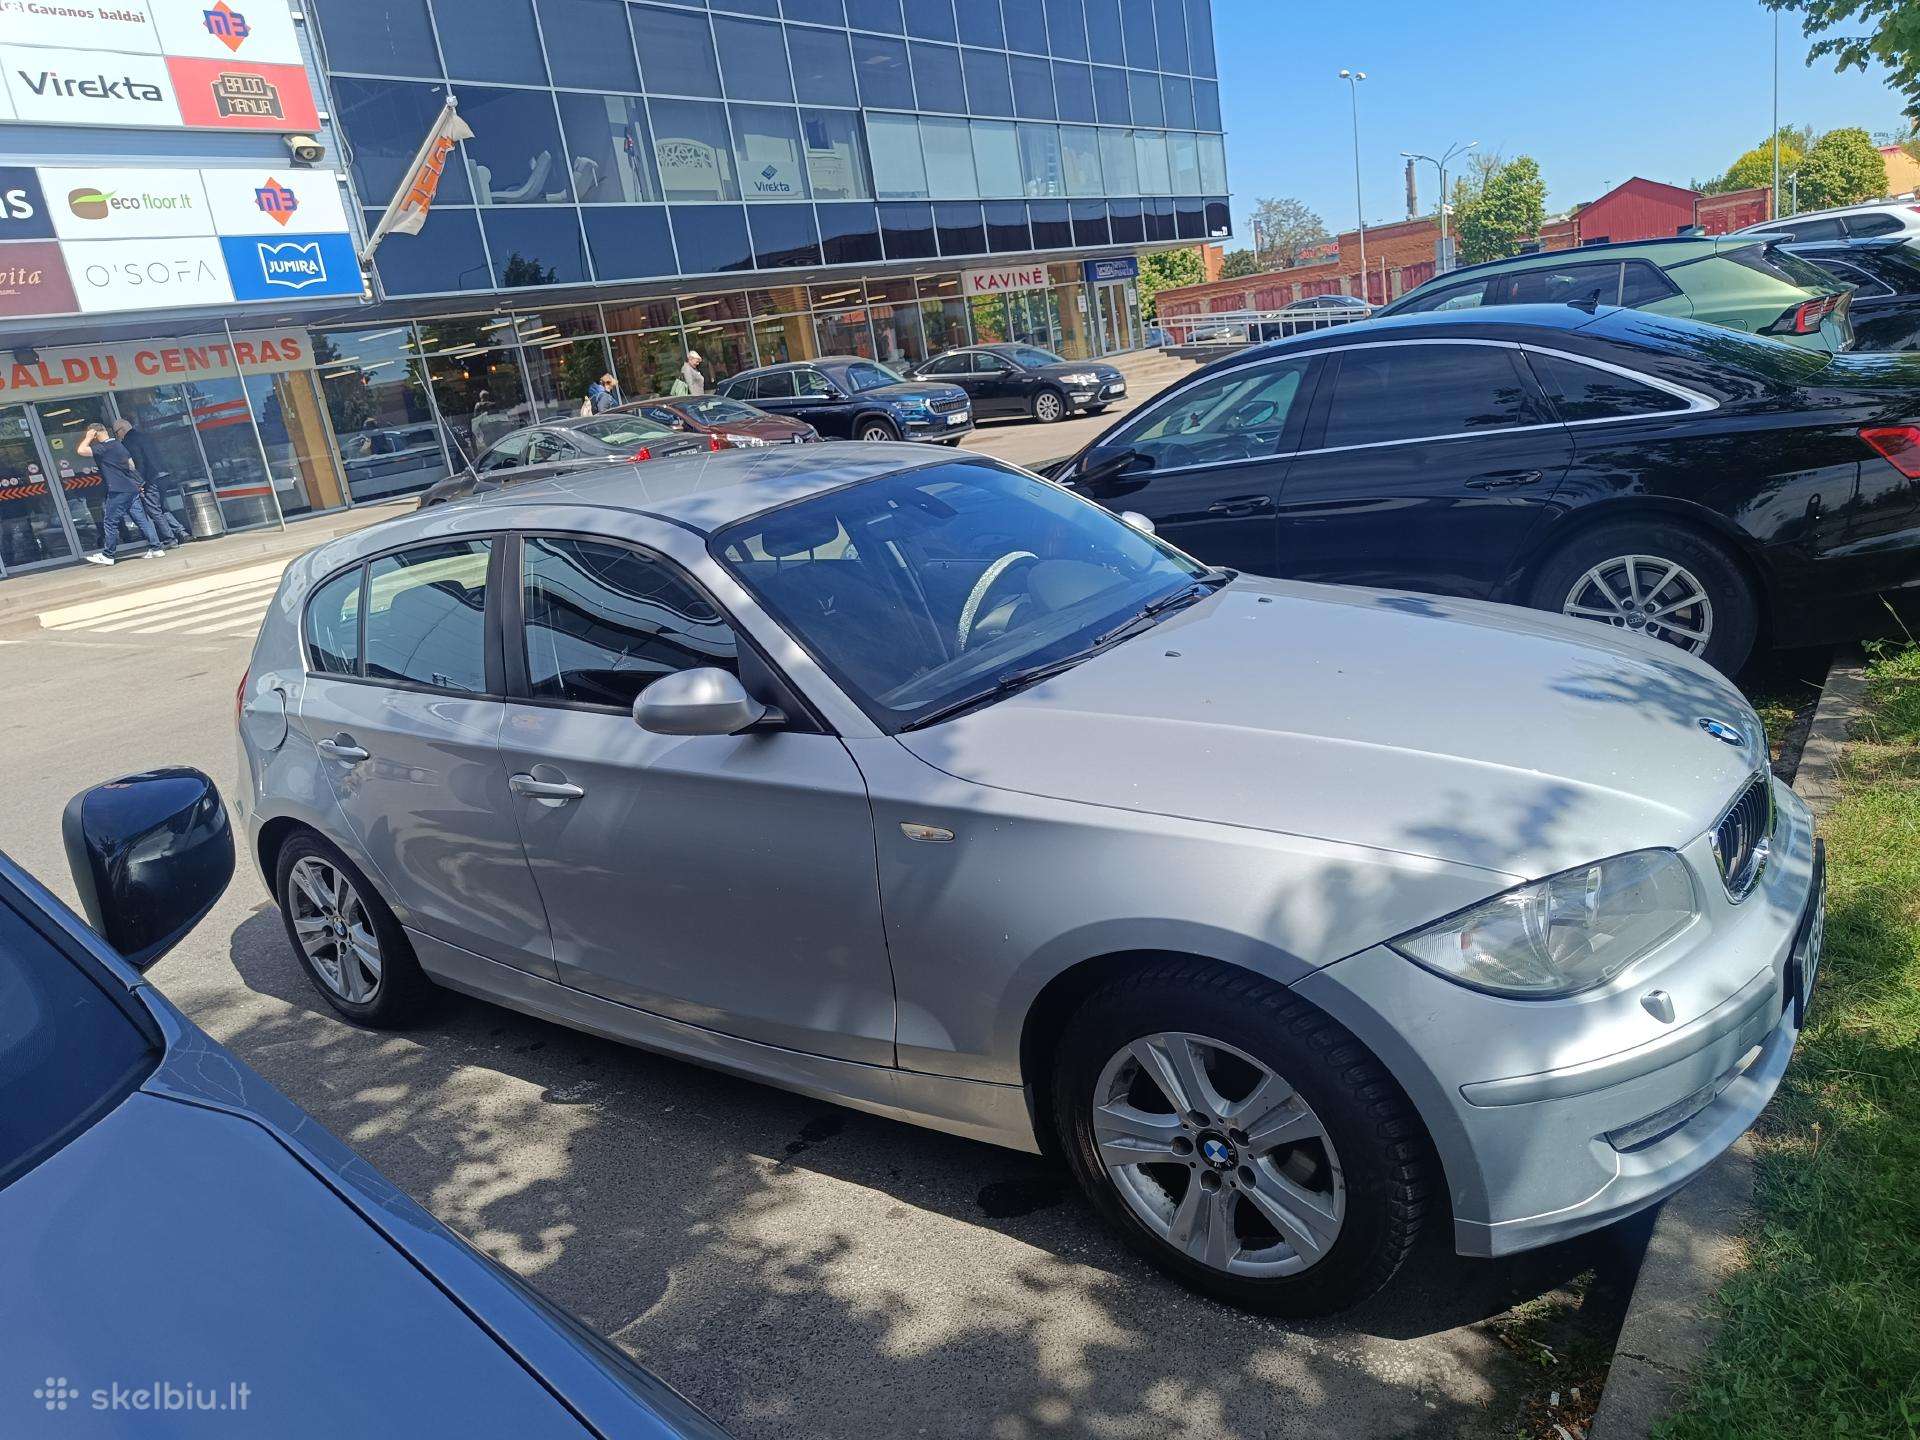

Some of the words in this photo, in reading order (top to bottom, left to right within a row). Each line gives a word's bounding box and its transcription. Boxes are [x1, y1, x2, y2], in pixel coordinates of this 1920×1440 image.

[28, 3, 94, 18] Gavanos
[98, 8, 146, 23] baldai
[17, 70, 163, 101] Virekta
[754, 181, 791, 192] Virekta
[269, 260, 319, 274] JUMIRA
[974, 268, 1043, 291] KAVINĖ
[0, 355, 118, 391] ALDŲ
[134, 338, 301, 375] CENTRAS
